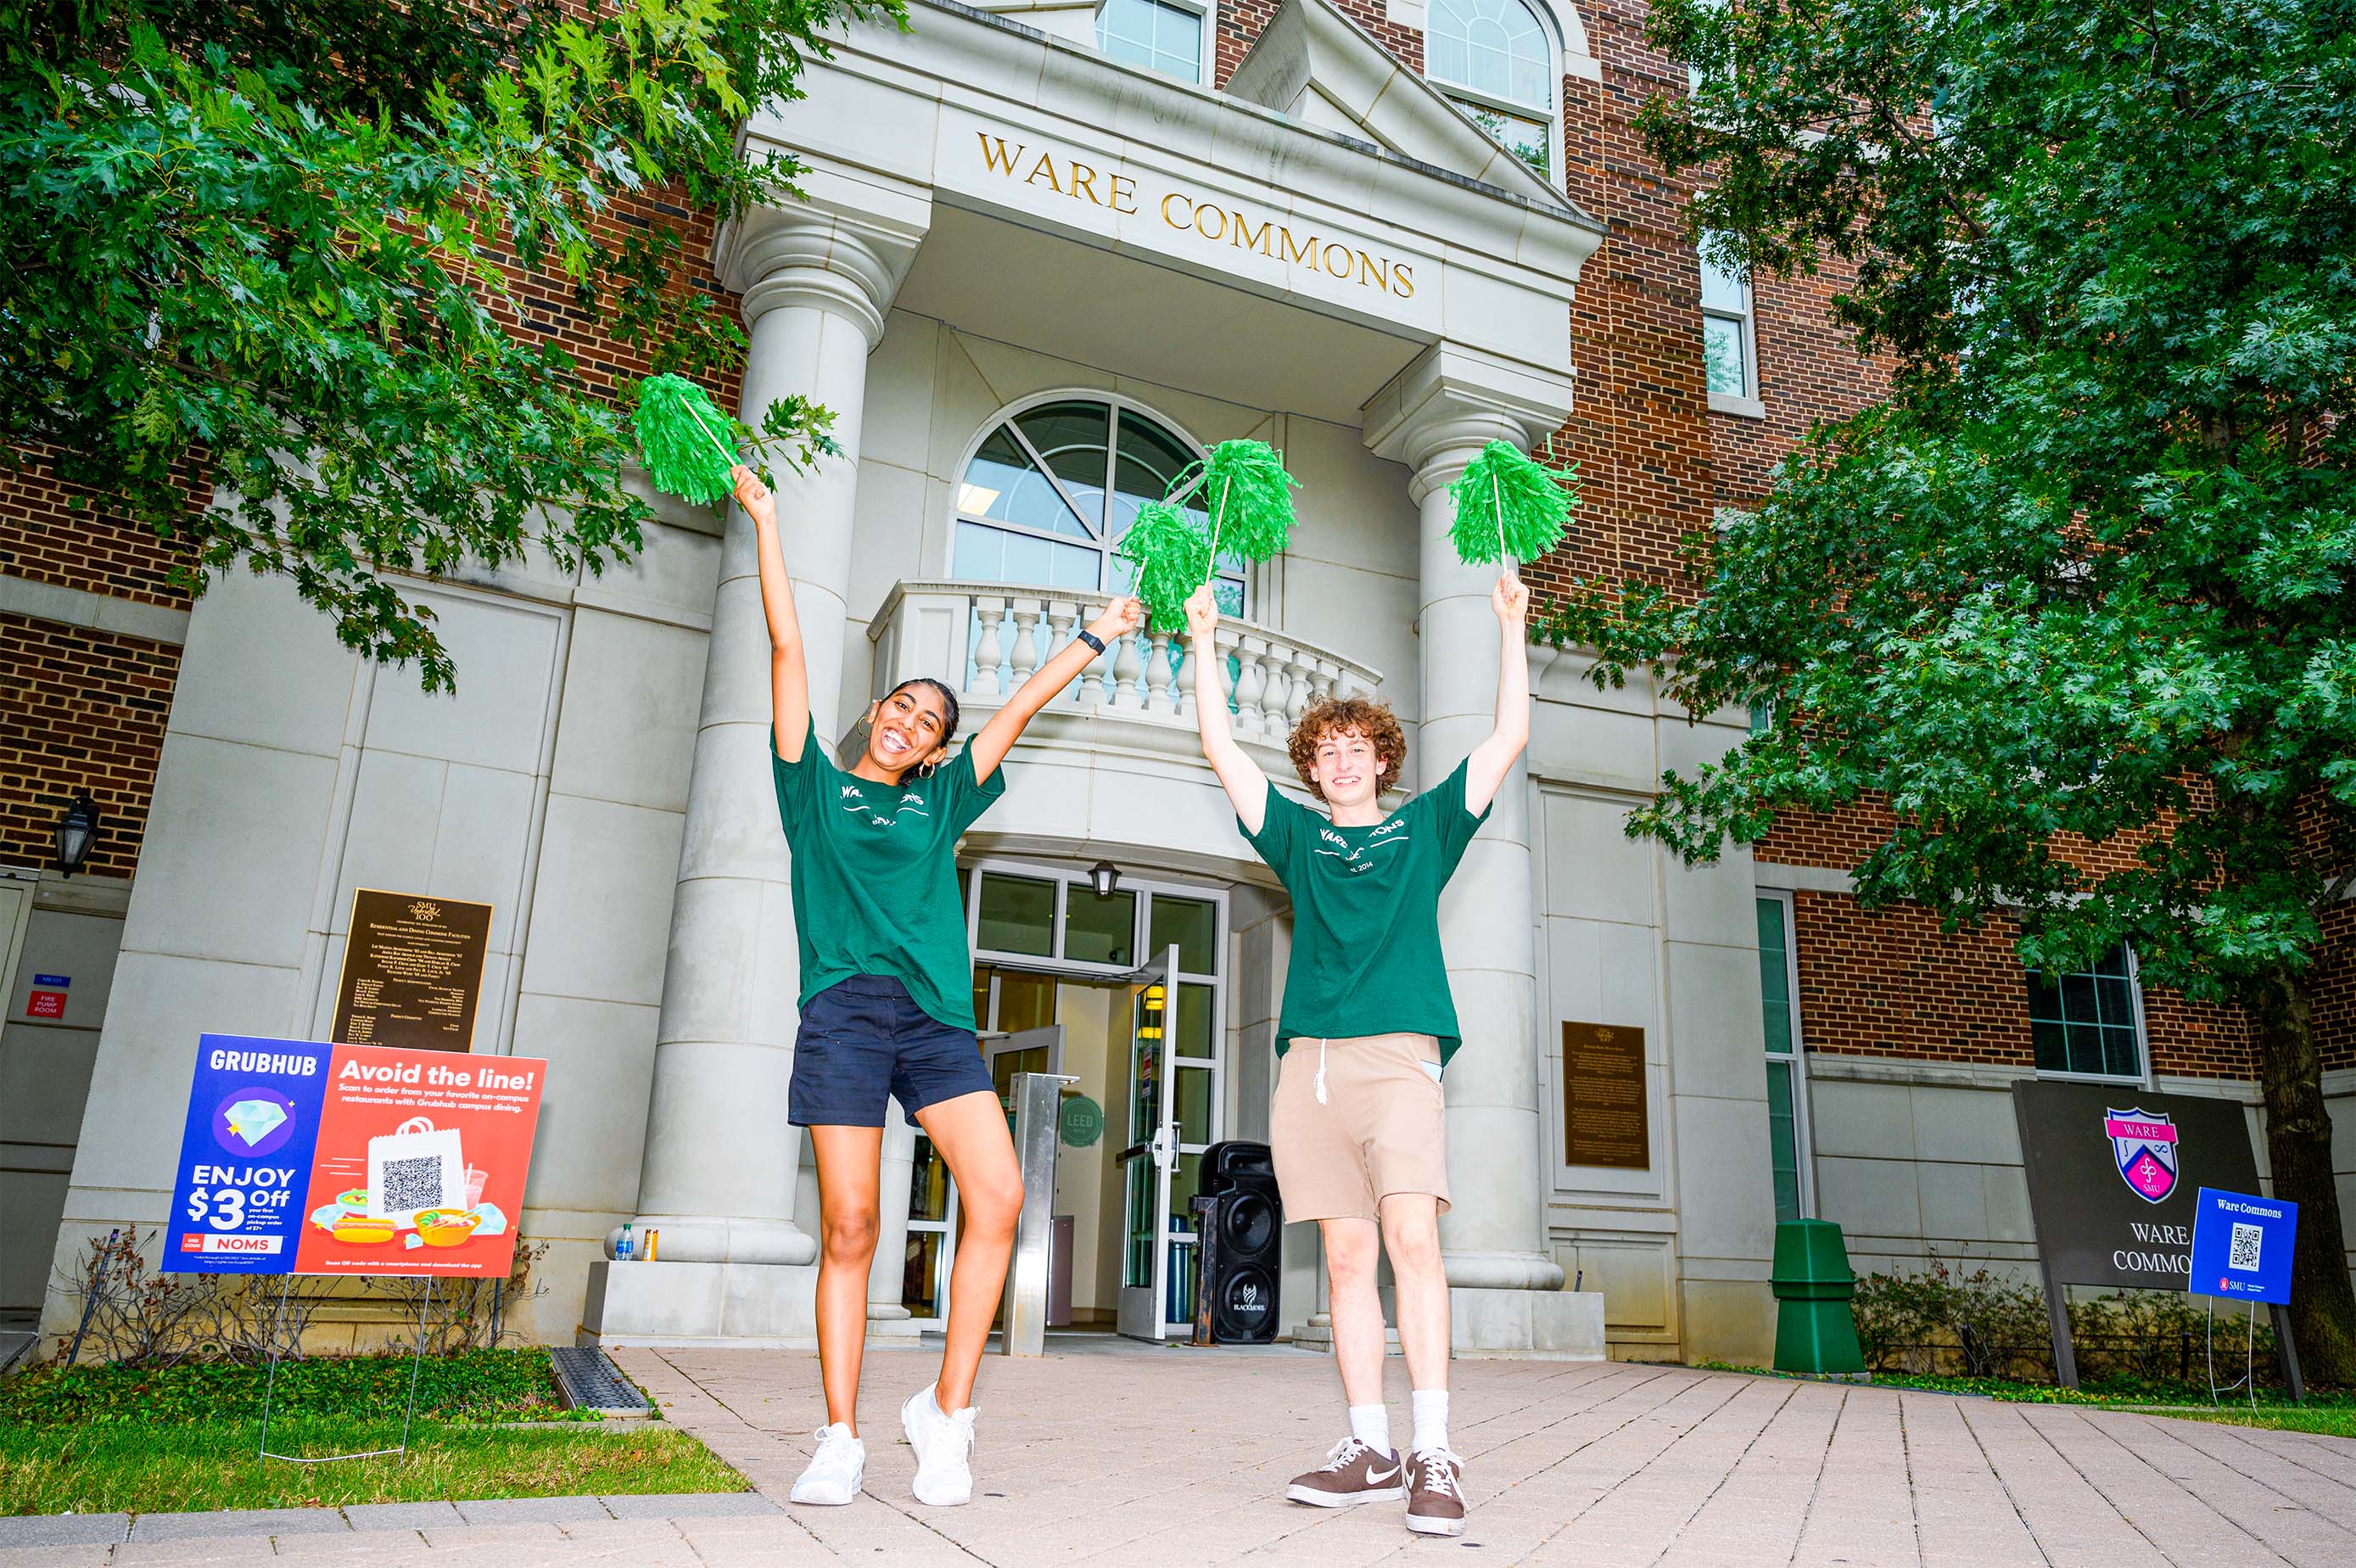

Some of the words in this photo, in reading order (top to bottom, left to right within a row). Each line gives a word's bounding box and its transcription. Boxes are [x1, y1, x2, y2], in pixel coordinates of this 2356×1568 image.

[976, 132, 1138, 216] WARE
[1161, 193, 1415, 299] COMMONS
[1358, 861, 1374, 871] 2014
[210, 1049, 316, 1076] GRUBHUB
[339, 1059, 422, 1085] Avoid
[428, 1065, 471, 1087] the
[478, 1067, 534, 1091] line!
[338, 1084, 361, 1092] Scan
[375, 1086, 399, 1095] order
[401, 1087, 422, 1096] from
[424, 1089, 444, 1098] your
[446, 1090, 479, 1100] favorite
[481, 1093, 529, 1103] on-campus
[341, 1095, 393, 1104] restaurants
[395, 1097, 415, 1106] with
[417, 1099, 456, 1109] Grubhub
[458, 1102, 491, 1111] campus
[493, 1103, 522, 1113] dining.
[1067, 1114, 1093, 1127] LEED
[2124, 1124, 2160, 1139] WARE
[192, 1165, 296, 1187] ENJOY
[2143, 1183, 2160, 1193] SMU
[249, 1189, 291, 1207] Off
[187, 1187, 245, 1230] $3
[2217, 1198, 2240, 1213] Ware
[2240, 1202, 2282, 1219] Commons
[2129, 1223, 2190, 1246] WARE
[217, 1239, 269, 1250] NOMS
[2113, 1250, 2191, 1274] COMMO
[2229, 1280, 2245, 1292] SMU
